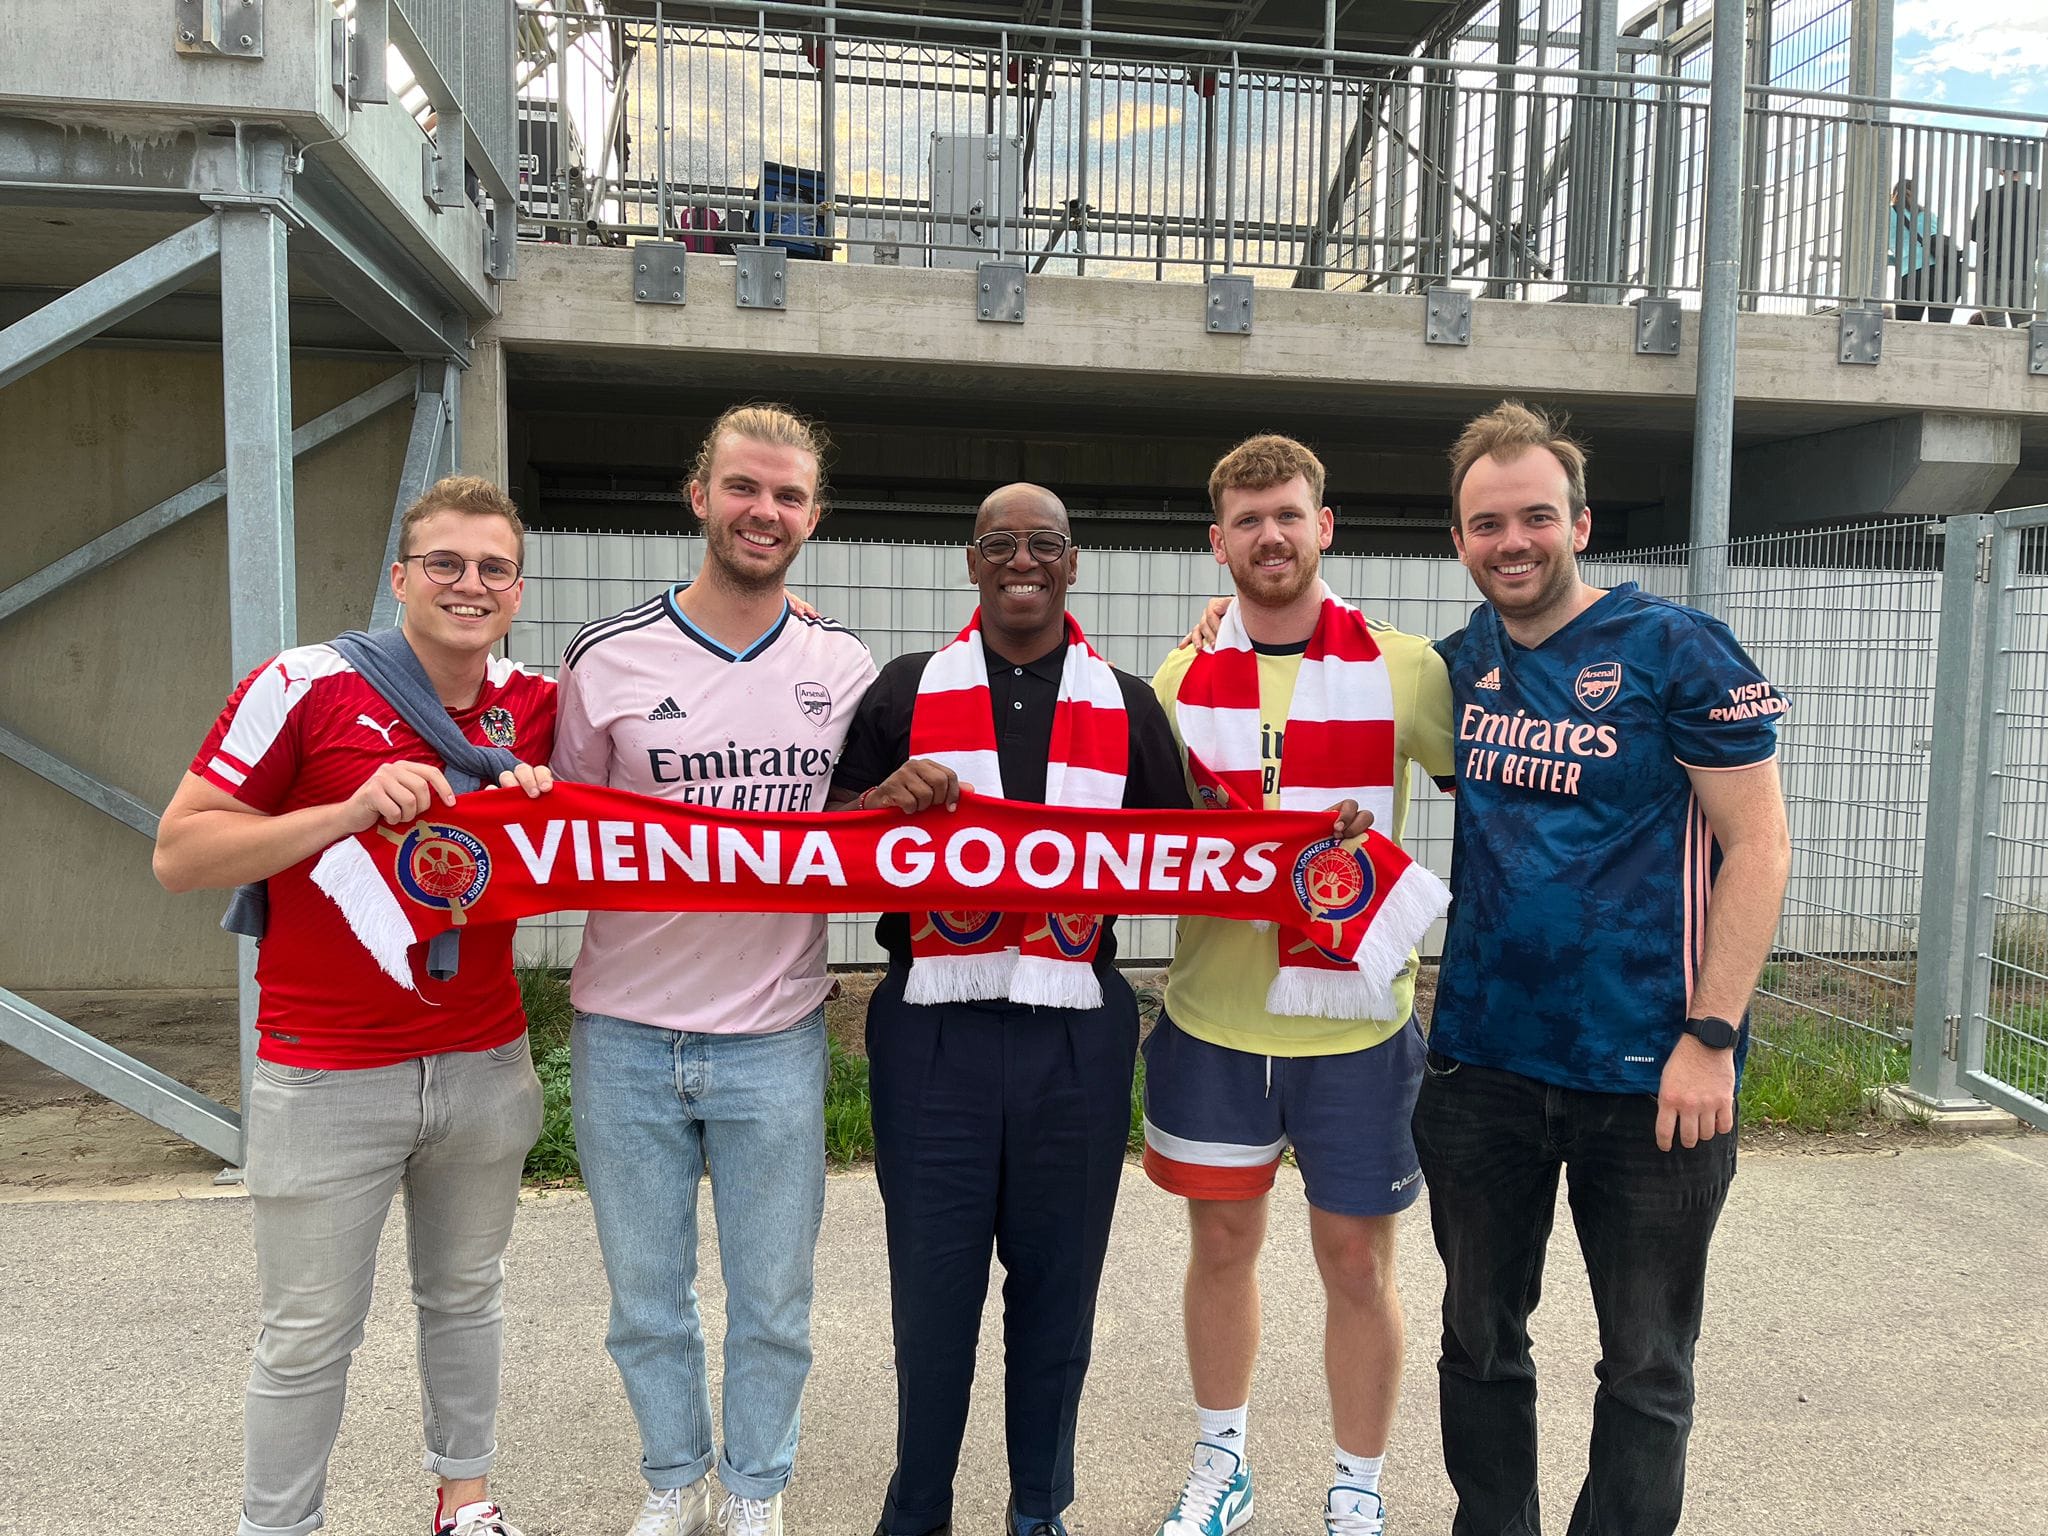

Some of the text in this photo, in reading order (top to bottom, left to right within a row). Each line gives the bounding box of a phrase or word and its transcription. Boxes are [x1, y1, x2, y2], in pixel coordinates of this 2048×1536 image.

[1474, 680, 1502, 691] adidas
[1584, 668, 1615, 679] Arsenal
[800, 689, 826, 698] Arsenal
[1728, 681, 1770, 704] VISIT
[648, 711, 687, 721] adidas
[1708, 697, 1790, 722] RWANDA
[1460, 703, 1618, 758] Emirates
[646, 741, 831, 783] Emirates
[1465, 748, 1582, 796] FLY BETTER
[732, 783, 813, 812] BETTER
[448, 829, 487, 899] VIENNA GOONERS
[504, 819, 1283, 892] VIENNA GOONERS
[1297, 840, 1331, 869] GOONERS
